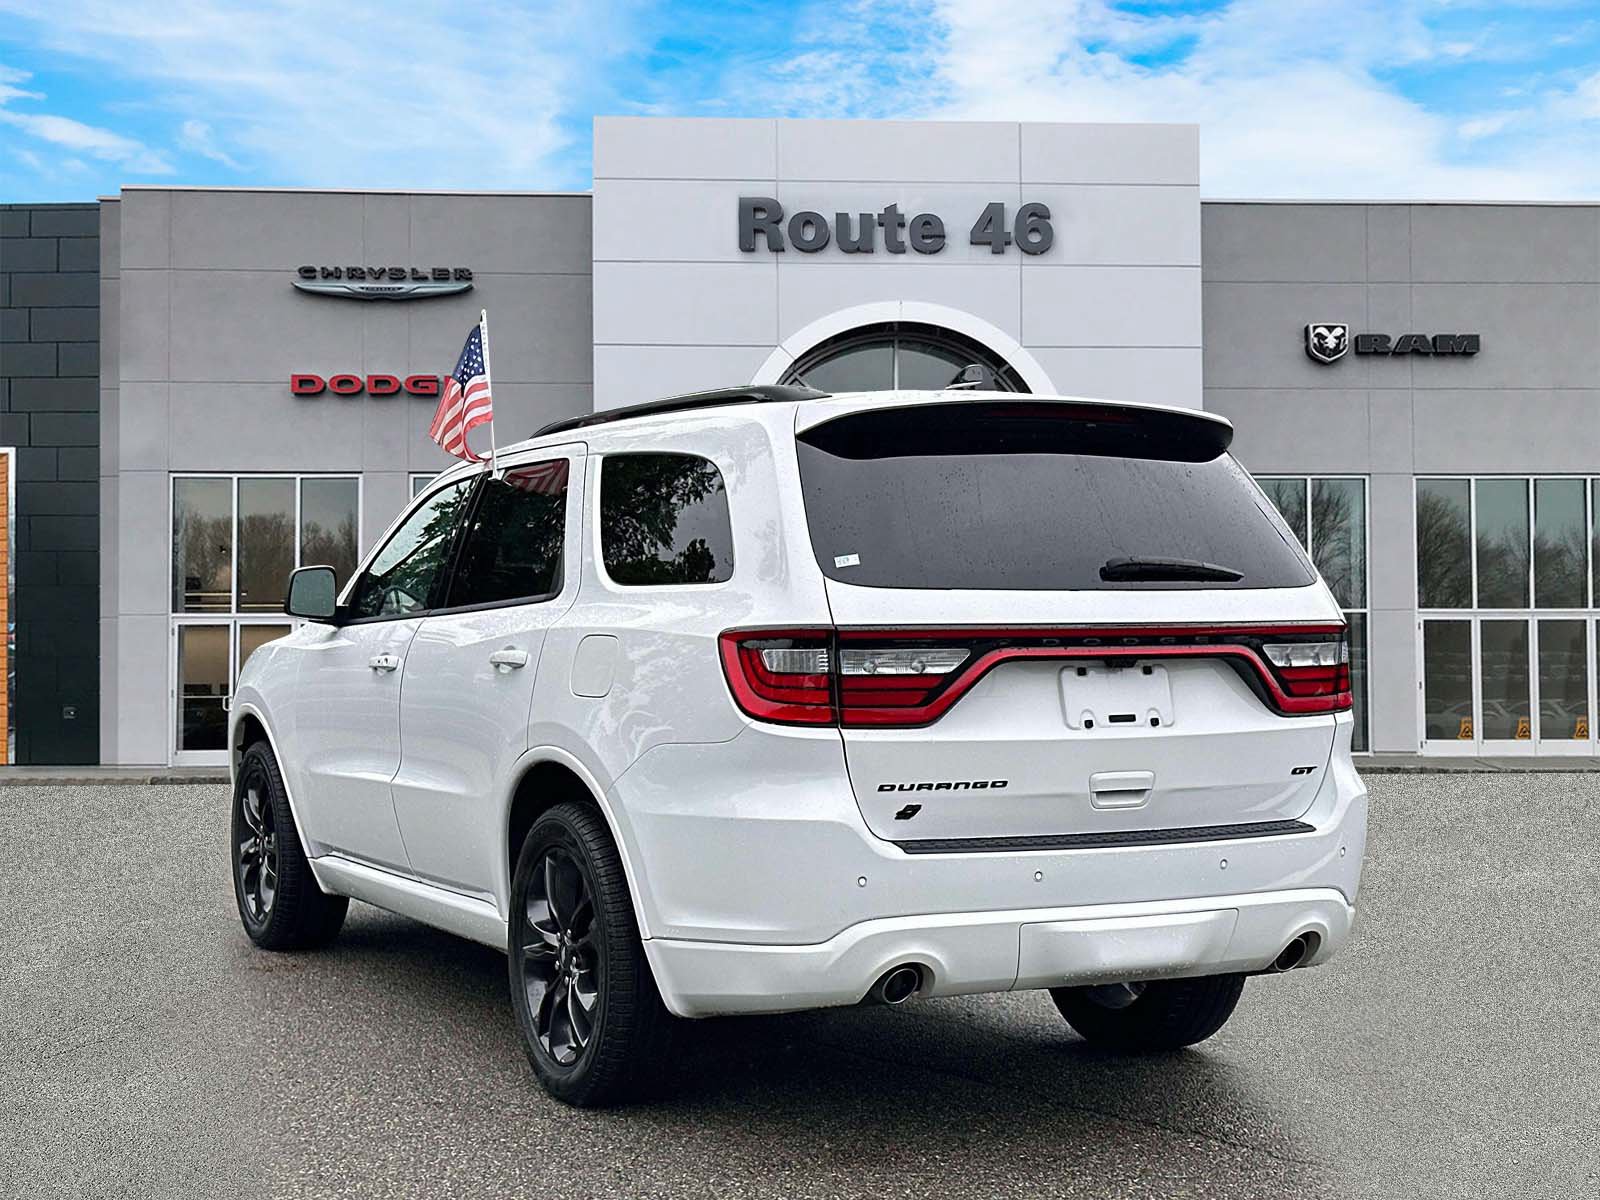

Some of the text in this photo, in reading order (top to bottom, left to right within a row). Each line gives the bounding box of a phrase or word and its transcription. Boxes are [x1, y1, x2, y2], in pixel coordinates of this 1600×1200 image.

[738, 197, 1054, 255] Route 46
[298, 266, 473, 280] CHRYSLER
[1355, 334, 1480, 356] RAM
[291, 374, 452, 397] DODG
[1042, 637, 1209, 646] DODGE
[1291, 766, 1317, 775] GT
[877, 780, 1009, 792] DURANGO
